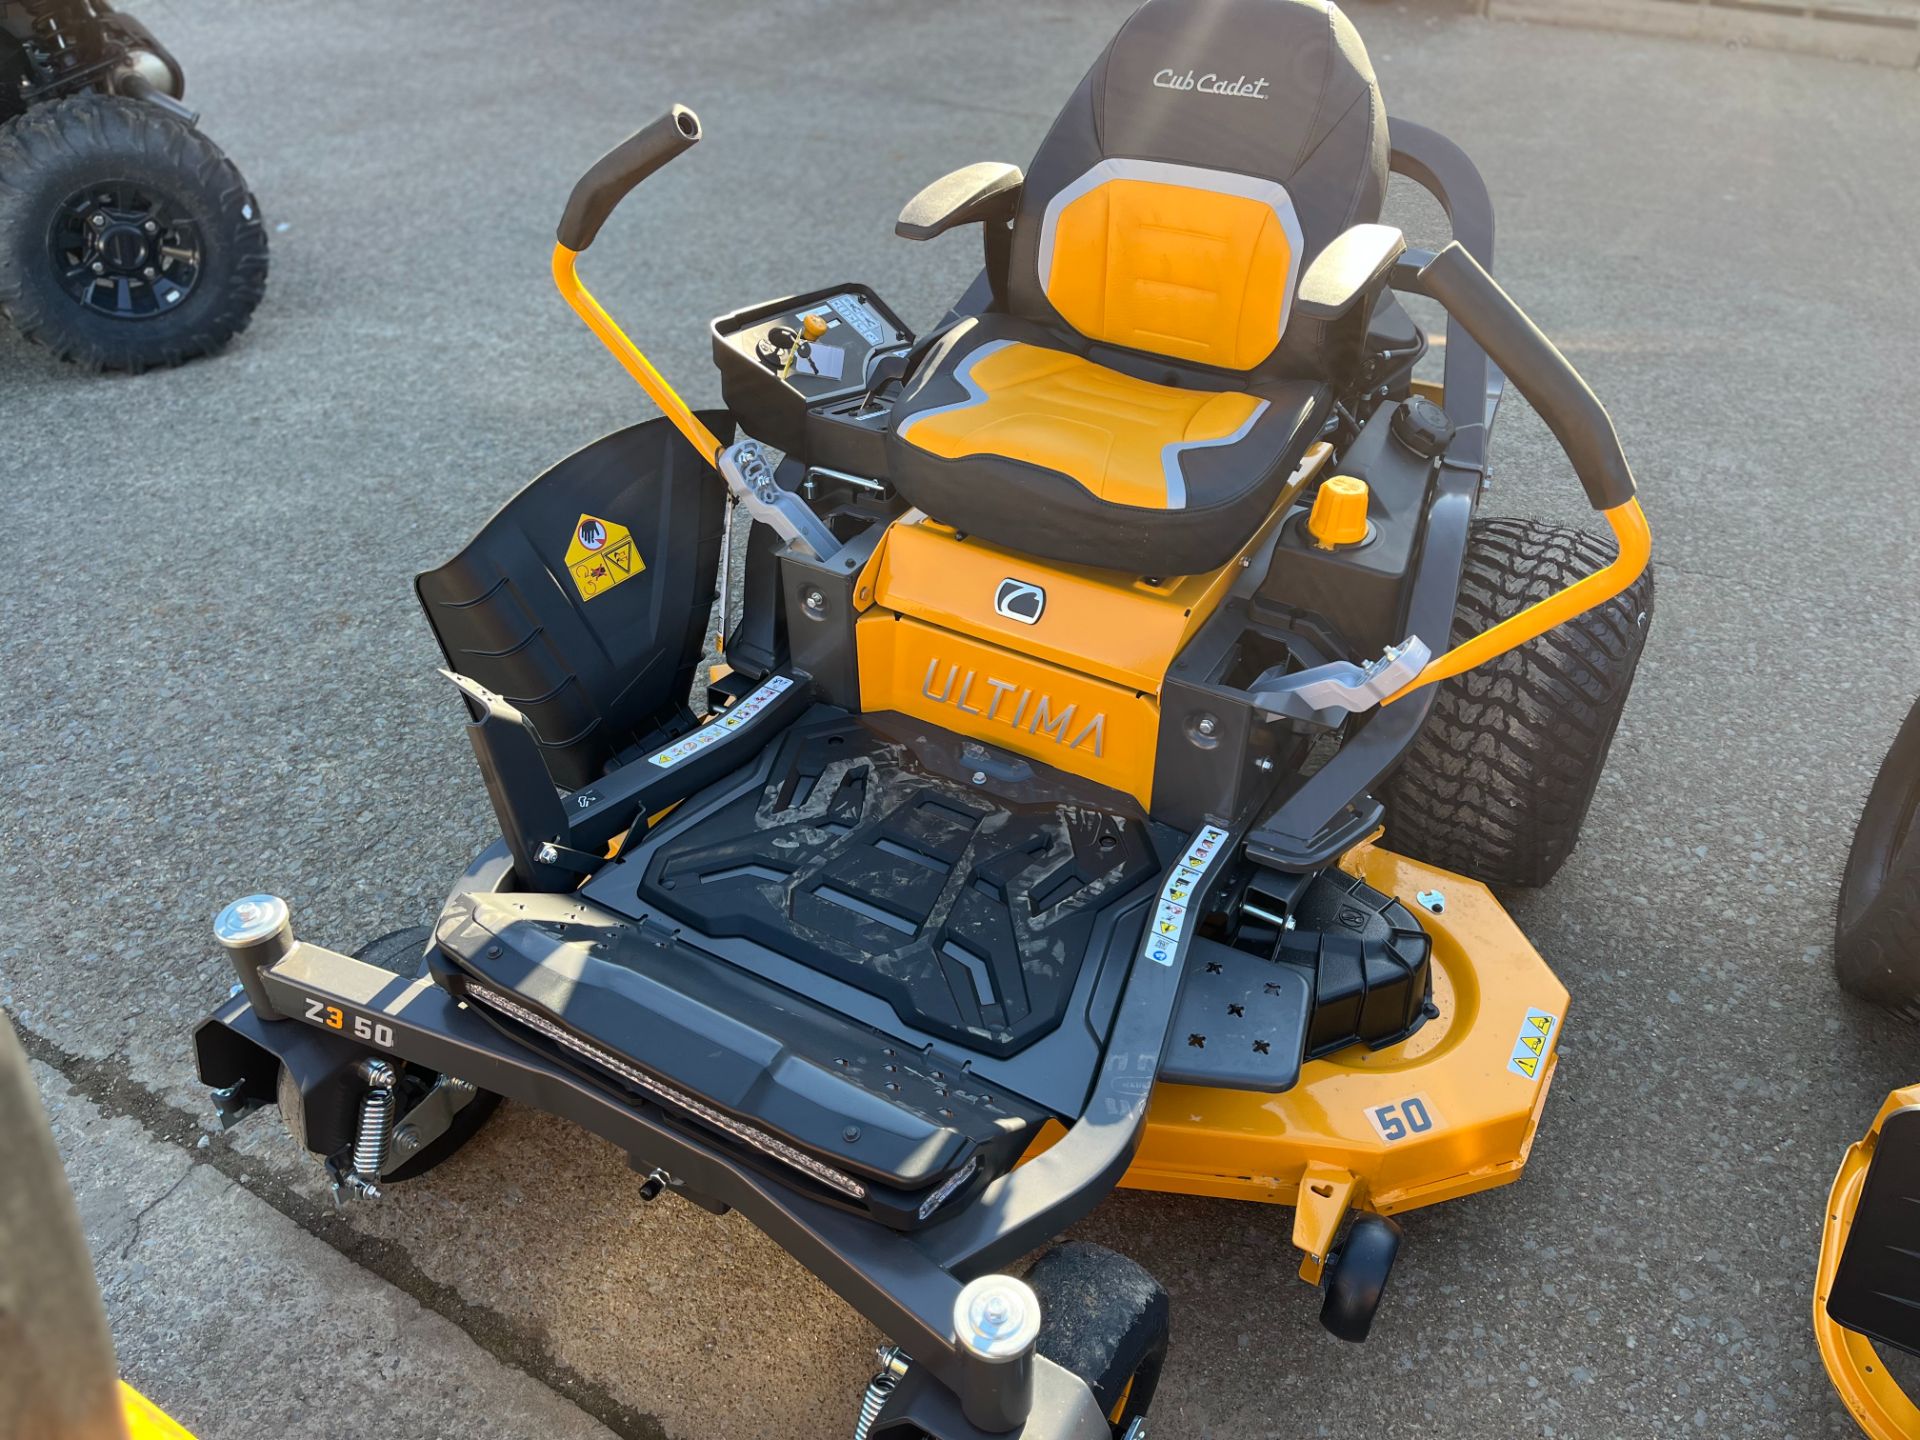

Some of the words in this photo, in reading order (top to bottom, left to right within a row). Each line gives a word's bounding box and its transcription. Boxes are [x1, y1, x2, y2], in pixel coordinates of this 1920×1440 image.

[1153, 68, 1194, 91] Cub
[1197, 73, 1269, 99] Cadet
[922, 658, 1105, 757] ULTIMA
[305, 997, 343, 1030] Z3
[354, 1015, 393, 1048] 50
[1375, 1098, 1432, 1141] 50
